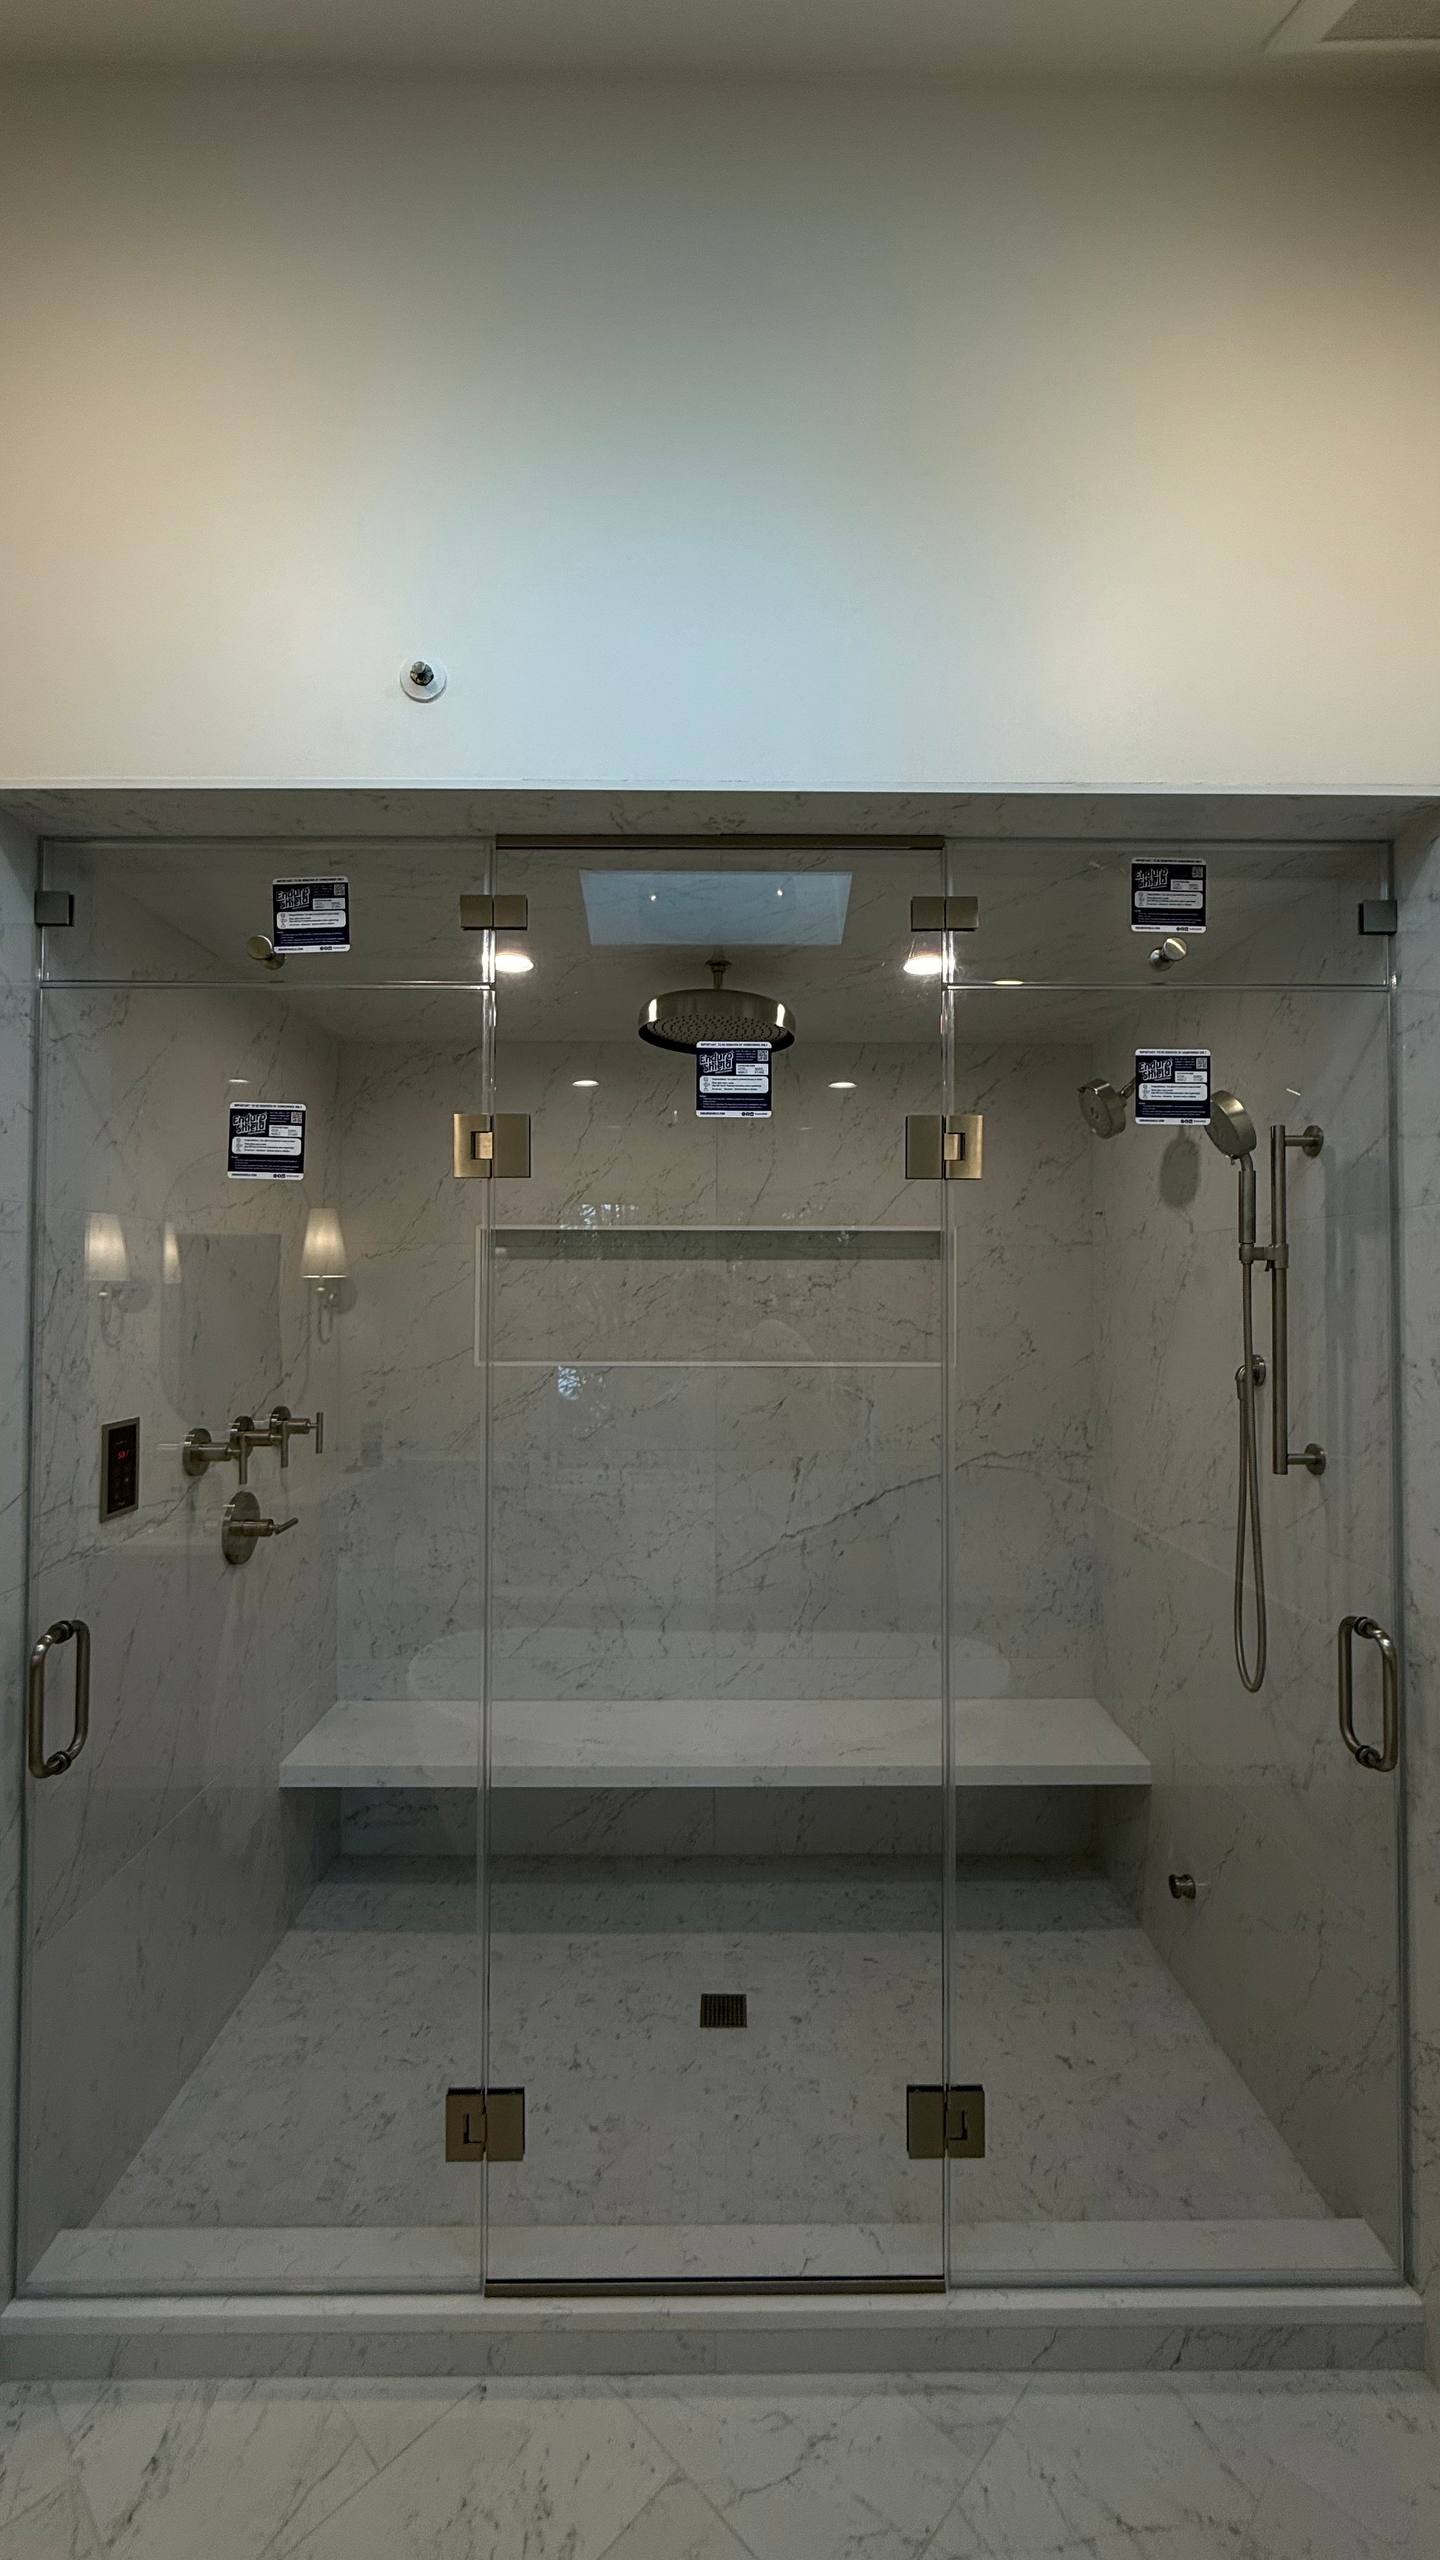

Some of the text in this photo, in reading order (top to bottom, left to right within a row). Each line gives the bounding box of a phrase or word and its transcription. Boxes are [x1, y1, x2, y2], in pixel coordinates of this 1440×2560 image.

[700, 1052, 733, 1065] Enduro
[703, 1060, 732, 1073] Shield
[233, 1113, 267, 1126] Enduro
[236, 1120, 266, 1134] Shield
